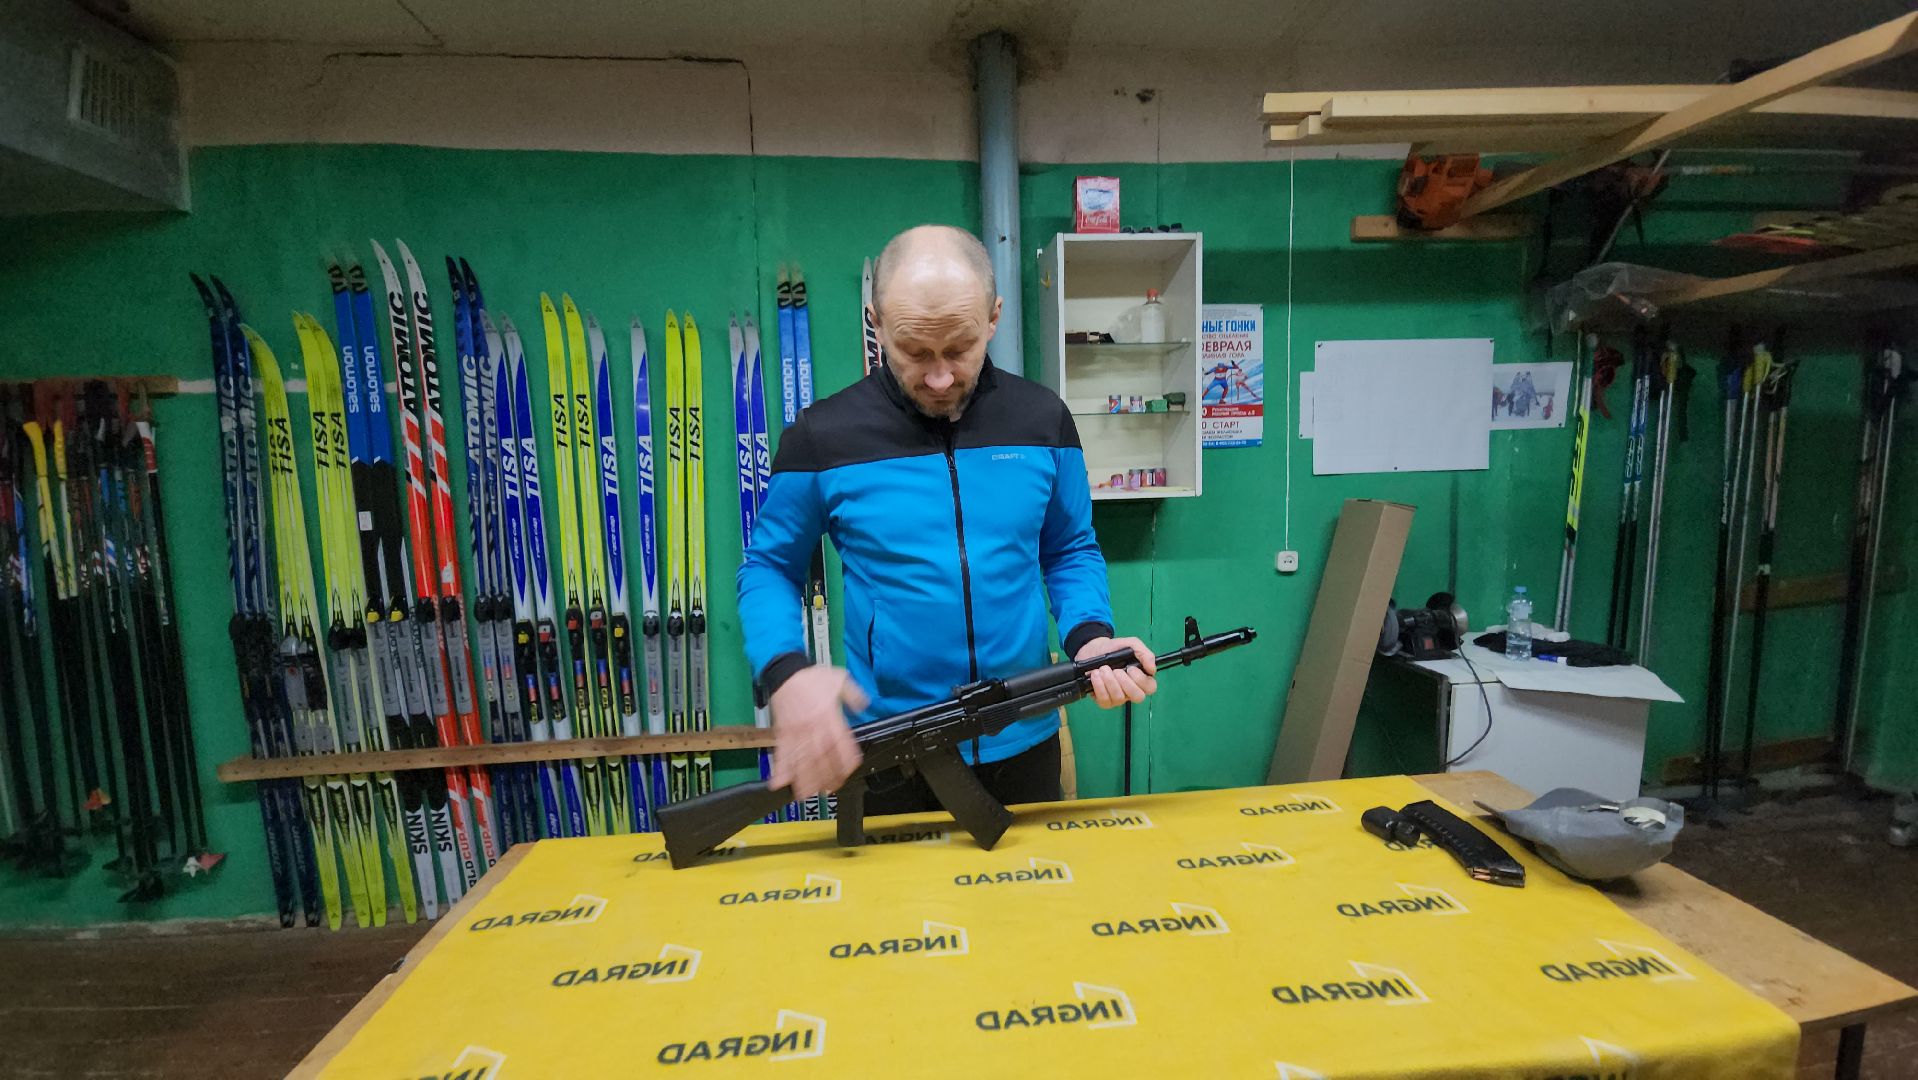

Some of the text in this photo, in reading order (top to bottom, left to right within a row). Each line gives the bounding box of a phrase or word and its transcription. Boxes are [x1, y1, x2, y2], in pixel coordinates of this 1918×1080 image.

[389, 291, 416, 416] ATOMIC
[413, 291, 442, 417] ATOMIC
[1226, 320, 1255, 332] ГОНКИ
[342, 345, 360, 414] salomon
[363, 345, 381, 414] salomon
[461, 354, 480, 465] ATOMIC
[479, 354, 498, 465] ATOMIC
[274, 417, 294, 475] TISA
[313, 411, 330, 470] TISA
[330, 411, 348, 470] TISA
[553, 393, 570, 449] TISA
[575, 393, 592, 449] TISA
[668, 407, 682, 462] TISA
[689, 407, 701, 462] TISA
[1212, 421, 1240, 430] СТАРТ
[501, 437, 520, 500] TISA
[521, 437, 540, 500] TISA
[601, 435, 619, 497] TISA
[638, 435, 654, 496] TISA
[738, 432, 755, 494] TISA
[410, 811, 429, 855] SKIN
[432, 810, 453, 853] SKIN
